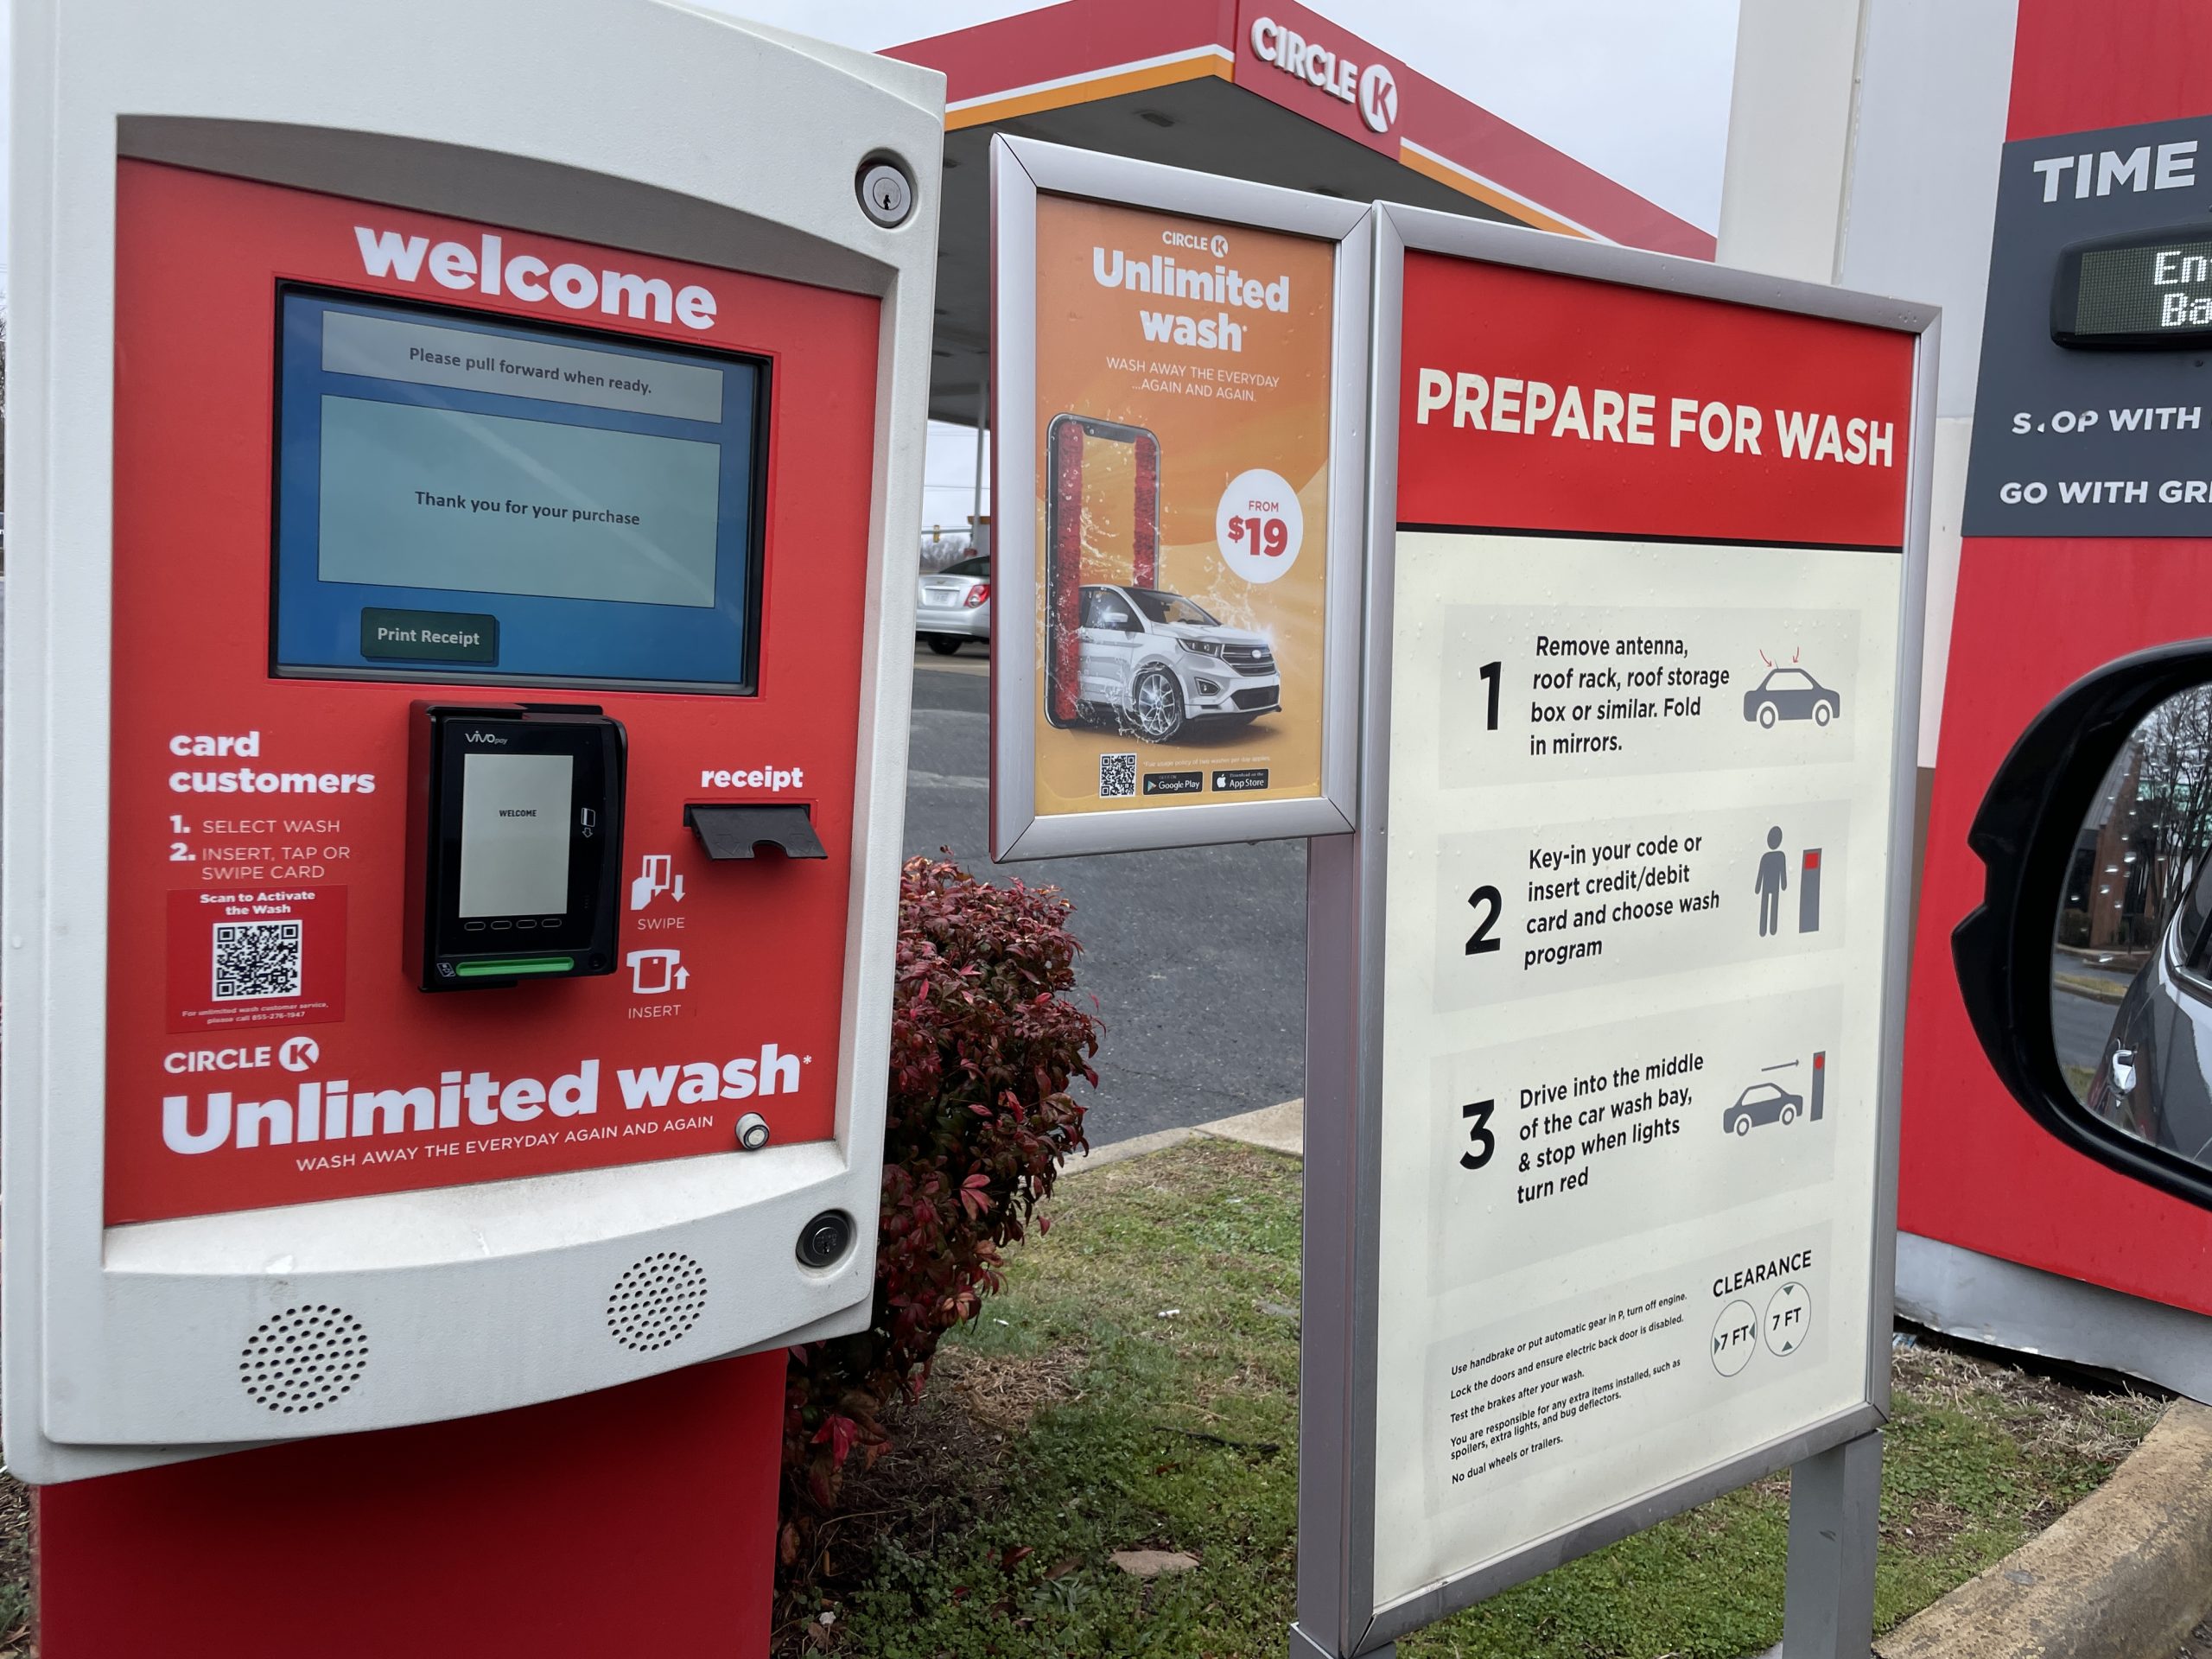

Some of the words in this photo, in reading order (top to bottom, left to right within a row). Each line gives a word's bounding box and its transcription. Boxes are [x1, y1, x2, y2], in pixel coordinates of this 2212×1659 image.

[1251, 17, 1358, 104] CIRCLE
[1362, 65, 1398, 132] K
[2033, 140, 2198, 202] TIME
[1162, 231, 1208, 251] CIRCLE
[1212, 236, 1228, 257] K
[354, 226, 717, 329] welcome
[1093, 247, 1289, 313] Unlimited
[2154, 251, 2212, 285] En
[410, 347, 461, 366] Please
[466, 358, 494, 372] pull
[499, 359, 559, 380] forward
[563, 371, 604, 387] when
[609, 378, 652, 396] ready.
[1106, 356, 1146, 372] WASH
[1149, 362, 1186, 377] AWAY
[1190, 366, 1214, 380] THE
[1217, 370, 1279, 387] EVERYDAY
[1185, 383, 1212, 397] AND
[1417, 368, 1656, 445] PREPARE
[1670, 397, 1762, 455] FOR
[1775, 410, 1893, 467] WASH
[2012, 410, 2099, 434] SOP
[2108, 407, 2202, 431] WITH
[415, 491, 466, 509] Thank
[471, 499, 500, 513] you
[505, 499, 529, 514] for
[532, 505, 569, 518] your
[572, 509, 639, 525] purchase
[1249, 500, 1279, 512] FROM
[1999, 482, 2048, 505] GO
[2058, 481, 2149, 504] WITH
[2158, 480, 2212, 504] GR
[1228, 515, 1287, 556] $19
[378, 627, 416, 642] Print
[422, 630, 480, 647] Receipt
[1536, 636, 1610, 656] Remove
[1616, 636, 1688, 658] antenna,
[1533, 668, 1573, 690] roof
[1579, 667, 1621, 691] rack,
[1627, 666, 1663, 687] roof
[1668, 667, 1730, 689] storage
[1479, 661, 1502, 730] 1
[1531, 702, 1566, 722] box
[1572, 705, 1592, 721] or
[1597, 698, 1657, 720] similar.
[1664, 696, 1700, 717] Fold
[169, 731, 259, 757] card
[1530, 734, 1546, 755] in
[1553, 733, 1622, 754] mirrors.
[169, 768, 375, 793] customers
[702, 766, 804, 791] receipt
[1159, 780, 1184, 791] Google
[1185, 780, 1199, 789] Play
[1230, 779, 1244, 789] App
[169, 815, 191, 834] 1.
[203, 820, 276, 833] SELECT
[283, 820, 340, 833] WASH
[169, 842, 196, 861] 2.
[203, 848, 275, 861] INSERT,
[281, 847, 317, 860] TAP
[323, 847, 350, 859] OR
[1529, 844, 1586, 871] Key-in
[1592, 843, 1630, 866] your
[1637, 835, 1678, 857] code
[1684, 836, 1702, 852] or
[201, 866, 264, 880] SWIPE
[270, 865, 325, 879] CARD
[1529, 878, 1580, 902] insert
[1586, 864, 1689, 894] credit/debit
[200, 893, 236, 904] Scan
[238, 893, 254, 902] to
[257, 891, 315, 901] Activate
[226, 906, 250, 915] the
[252, 905, 291, 914] Wash
[1527, 909, 1567, 934] card
[1573, 904, 1606, 928] and
[1612, 900, 1673, 922] choose
[1679, 890, 1719, 912] wash
[638, 917, 685, 930] SWIPE
[1465, 885, 1502, 956] 2
[1524, 940, 1602, 970] program
[628, 1004, 681, 1019] INSERT
[163, 1046, 270, 1074] CIRCLE
[283, 1038, 319, 1071] K
[1521, 1084, 1567, 1109] Drive
[1574, 1075, 1607, 1097] into
[1613, 1067, 1640, 1088] the
[1646, 1053, 1703, 1081] middle
[162, 1059, 600, 1154] Unlimited
[1520, 1117, 1538, 1141] of
[1544, 1114, 1573, 1135] the
[1579, 1106, 1605, 1126] car
[1611, 1092, 1652, 1118] wash
[1658, 1088, 1692, 1108] bay,
[296, 1154, 355, 1172] WASH
[362, 1147, 418, 1165] AWAY
[424, 1142, 460, 1158] THE
[466, 1132, 559, 1154] EVERYDAY
[564, 1126, 617, 1143] AGAIN
[622, 1122, 658, 1136] AND
[663, 1116, 713, 1132] AGAIN
[1459, 1099, 1495, 1170] 3
[1518, 1153, 1530, 1173] &
[1536, 1145, 1575, 1168] stop
[1581, 1131, 1626, 1156] when
[1633, 1118, 1680, 1144] lights
[1517, 1180, 1554, 1204] turn
[1560, 1166, 1588, 1192] red
[1713, 1249, 1811, 1297] CLEARANCE
[1773, 1314, 1780, 1331] 7
[1785, 1307, 1802, 1326] FT
[1452, 1363, 1467, 1376] Use
[1470, 1347, 1515, 1370] handbrake
[1517, 1343, 1526, 1352] or
[1529, 1337, 1542, 1351] put
[1545, 1324, 1586, 1343] automatic
[1588, 1317, 1606, 1331] gear
[1609, 1314, 1616, 1323] in
[1618, 1311, 1624, 1319] P,
[1627, 1306, 1643, 1317] turn
[1645, 1300, 1656, 1311] off
[1658, 1294, 1687, 1307] engine.
[1720, 1333, 1728, 1351] 7
[1732, 1325, 1749, 1346] FT
[1451, 1384, 1471, 1400] Lock
[1474, 1380, 1488, 1391] the
[1491, 1370, 1516, 1385] doors
[1517, 1362, 1534, 1376] and
[1535, 1354, 1563, 1370] ensure
[1566, 1343, 1596, 1359] electric
[1599, 1335, 1618, 1348] back
[1619, 1329, 1638, 1341] door
[1649, 1314, 1683, 1332] disabled.
